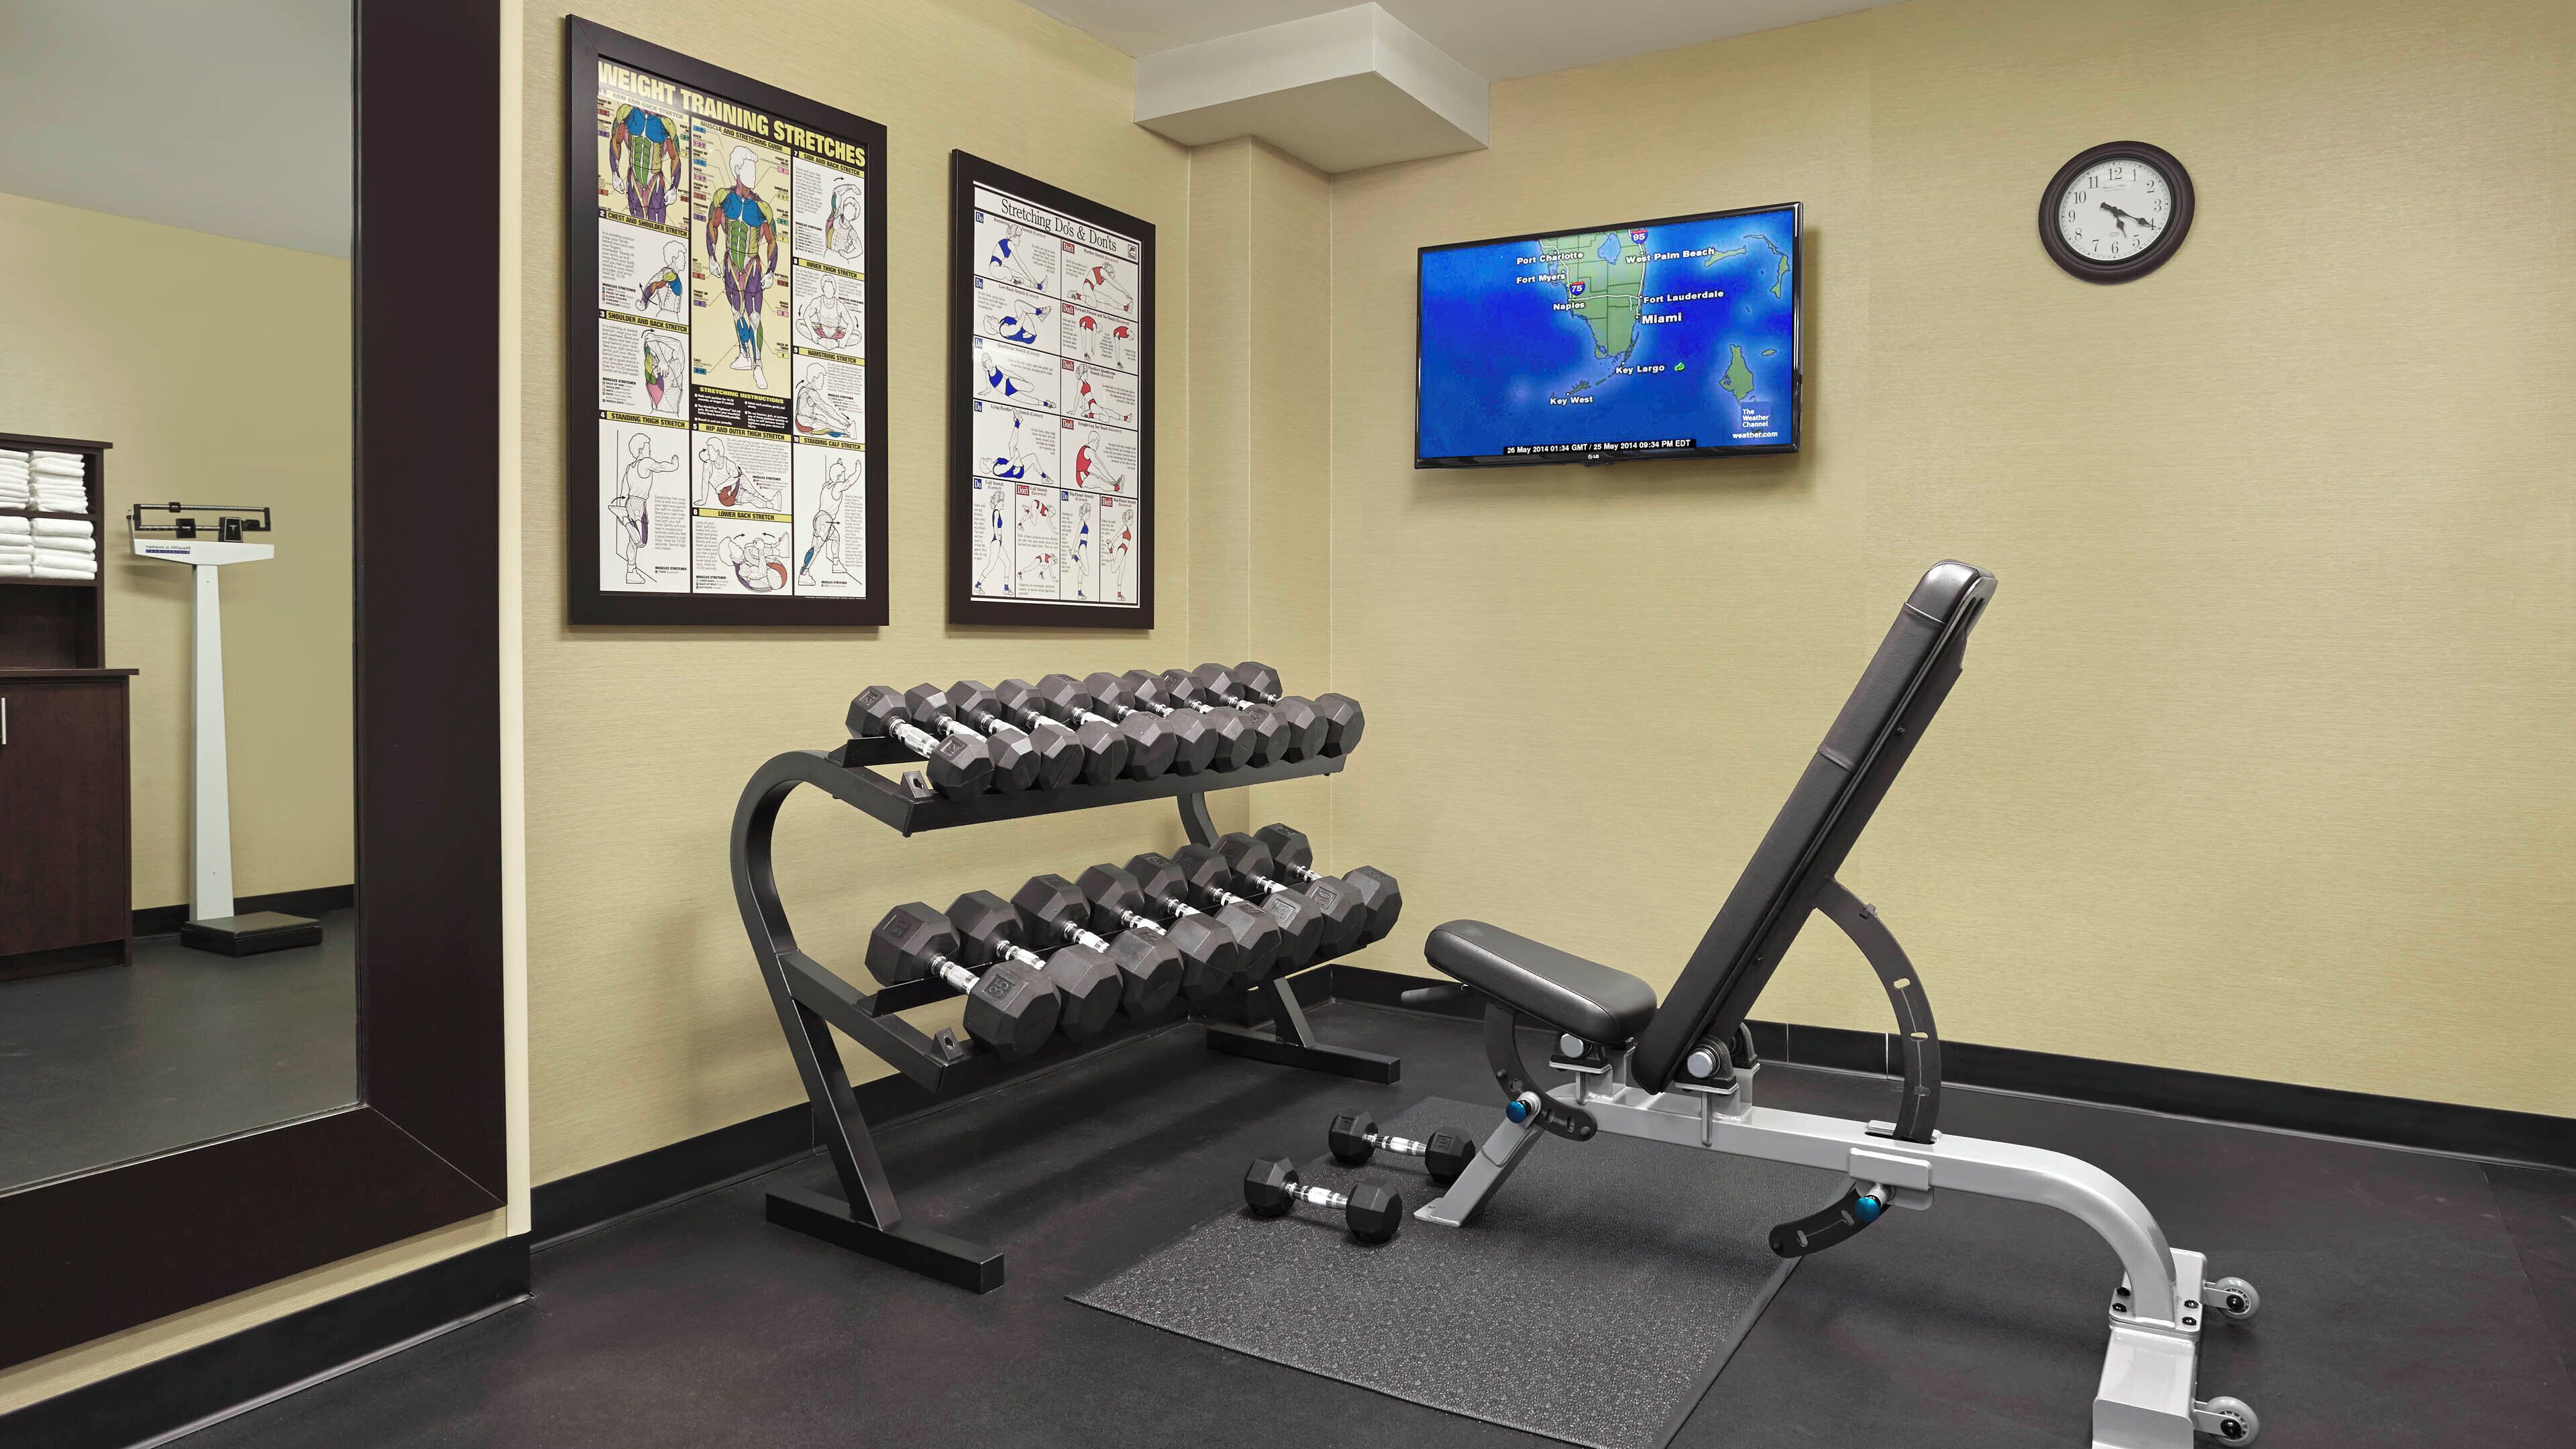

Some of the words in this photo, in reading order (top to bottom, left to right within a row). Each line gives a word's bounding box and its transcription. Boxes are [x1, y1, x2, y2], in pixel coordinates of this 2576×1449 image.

[612, 93, 626, 101] ARM
[628, 97, 640, 106] AND
[642, 101, 657, 111] BACK
[659, 106, 683, 119] STRETCH
[598, 61, 676, 105] WEIGHT
[680, 89, 768, 136] TRAINING
[773, 120, 865, 167] STRETCHES
[700, 121, 722, 132] MUSCLE
[724, 128, 734, 136] AND
[736, 131, 767, 146] STRETCHING
[768, 142, 783, 152] GUIDE
[804, 154, 814, 162] SIDE
[816, 157, 826, 165] AND
[827, 160, 839, 169] BACK
[841, 165, 860, 175] STRETCH
[2109, 167, 2122, 180] 12
[2088, 176, 2098, 189] 11
[2147, 180, 2155, 193] 2
[2074, 191, 2086, 204] 10
[2154, 199, 2161, 212] 3
[976, 212, 983, 223] Do
[2068, 209, 2076, 222] 9
[608, 213, 625, 221] CHEST
[639, 220, 664, 232] SHOULDER
[665, 227, 687, 237] STRETCH
[1002, 199, 1051, 232] Stretching
[1055, 217, 1074, 237] Do's
[1077, 226, 1085, 241] &
[1089, 229, 1117, 252] Don'ts
[2147, 217, 2156, 230] 4
[1633, 233, 1645, 241] 95
[2075, 228, 2082, 241] 8
[2133, 234, 2140, 247] 5
[1063, 242, 1073, 254] Don't
[2092, 239, 2099, 252] 7
[2111, 241, 2118, 254] 6
[1517, 256, 1536, 264] Port
[1540, 252, 1584, 262] Charlotte
[1626, 256, 1651, 264] West
[1654, 252, 1680, 260] Palm
[1682, 248, 1715, 258] Beach
[806, 262, 822, 270] INNER
[838, 270, 857, 278] STRETCH
[976, 278, 983, 288] Do
[1517, 276, 1536, 284] Fort
[1539, 273, 1566, 282] Myers
[1667, 291, 1724, 302] Lauderdale
[1063, 304, 1073, 315] Don't
[1553, 302, 1585, 311] Naples
[608, 313, 636, 323] SHOULDER
[665, 323, 687, 333] STRETCH
[1642, 313, 1682, 325] Miami
[808, 350, 835, 360] HAMSTRING
[1063, 360, 1073, 370] Don't
[1616, 366, 1633, 374] Key
[1637, 365, 1665, 374] Largo
[700, 386, 739, 397] STRETCHING
[741, 392, 784, 404] INSTRUCTIONS
[1550, 398, 1567, 406] Key
[1570, 396, 1593, 404] West
[975, 402, 981, 412] Do
[611, 413, 641, 423] STANDING
[661, 419, 685, 428] STRETCH
[1063, 419, 1073, 429] Don't
[804, 438, 827, 446] STANDING
[975, 480, 981, 488] Do
[1018, 486, 1029, 495] Don't
[1062, 492, 1068, 500] Do
[1102, 498, 1112, 506] Don't
